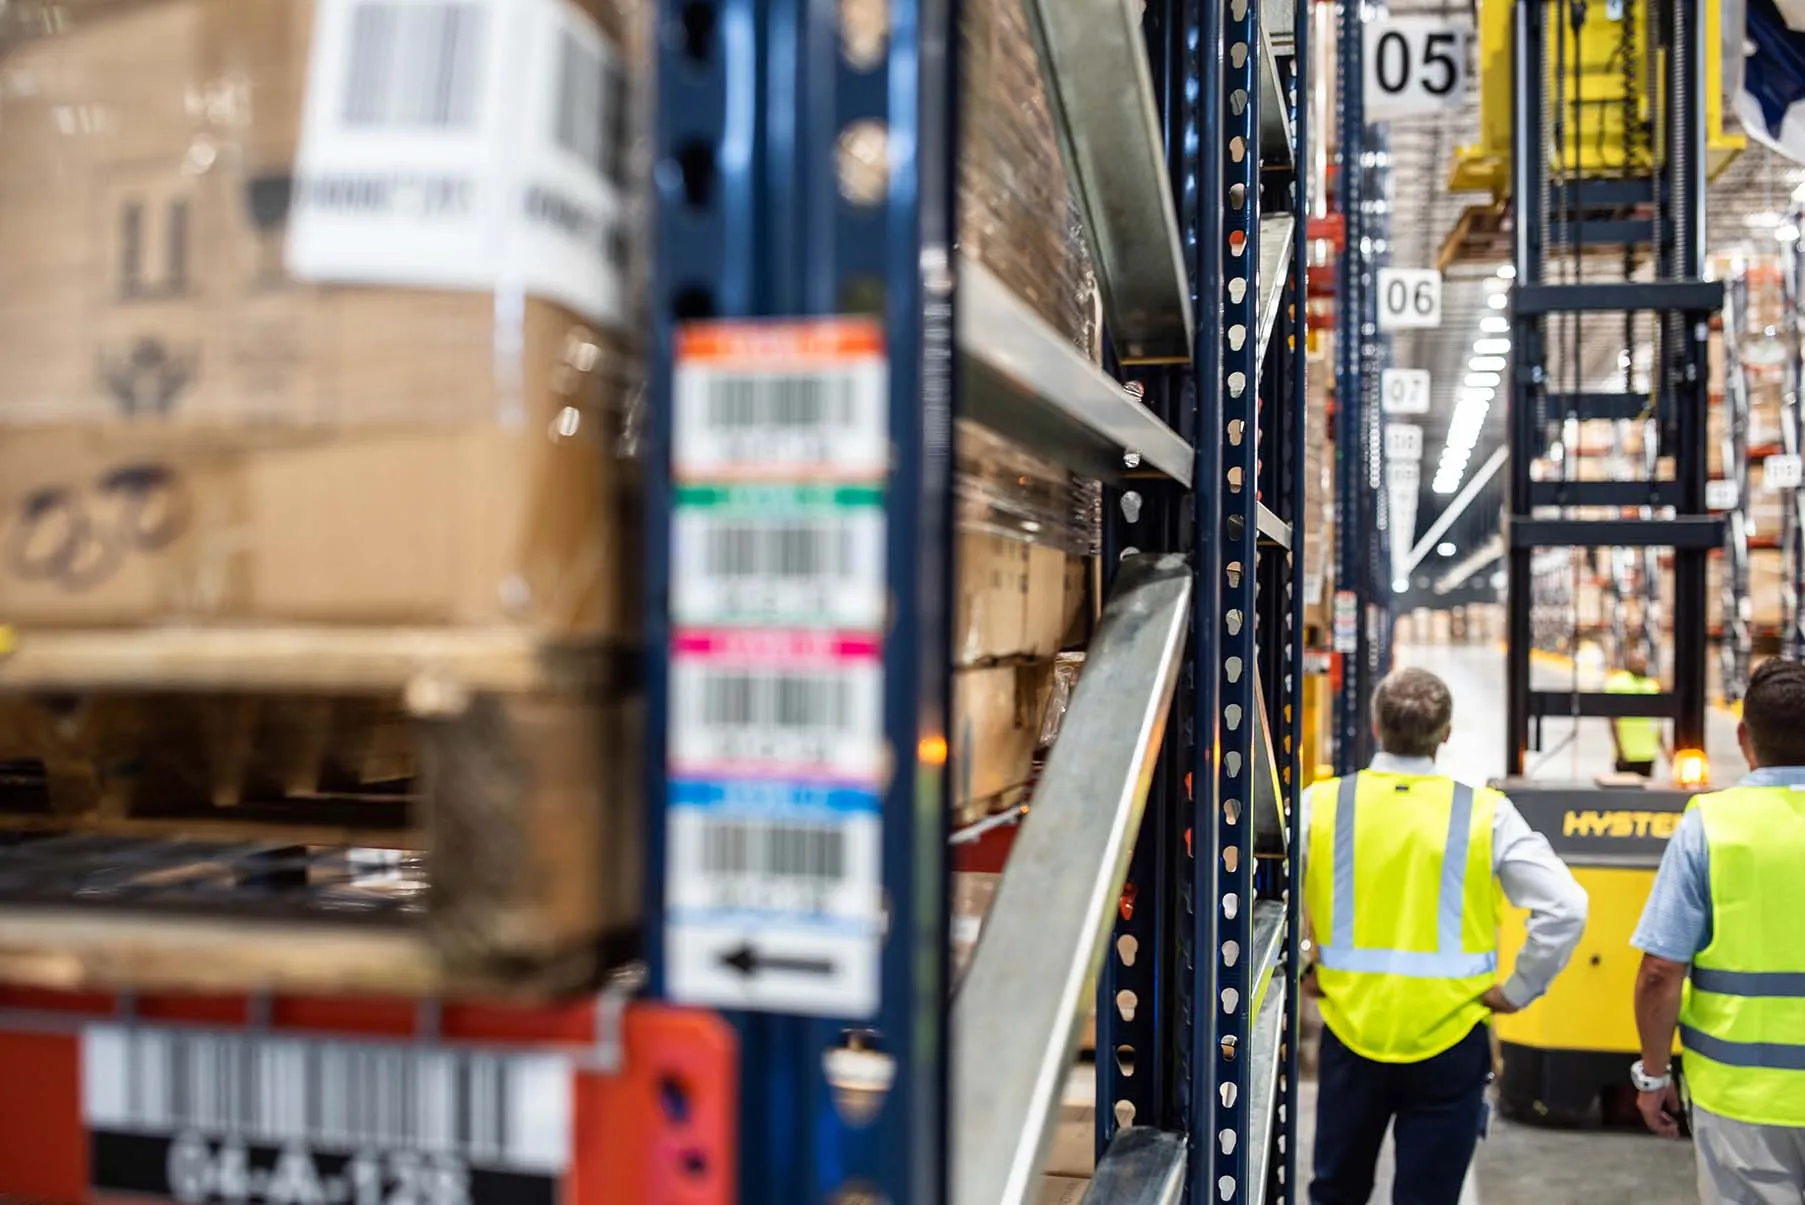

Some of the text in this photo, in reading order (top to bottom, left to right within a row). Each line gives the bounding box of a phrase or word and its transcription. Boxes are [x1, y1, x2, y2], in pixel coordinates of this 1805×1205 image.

[1376, 30, 1457, 96] 05
[1387, 279, 1434, 315] 06
[1391, 379, 1421, 404] 07
